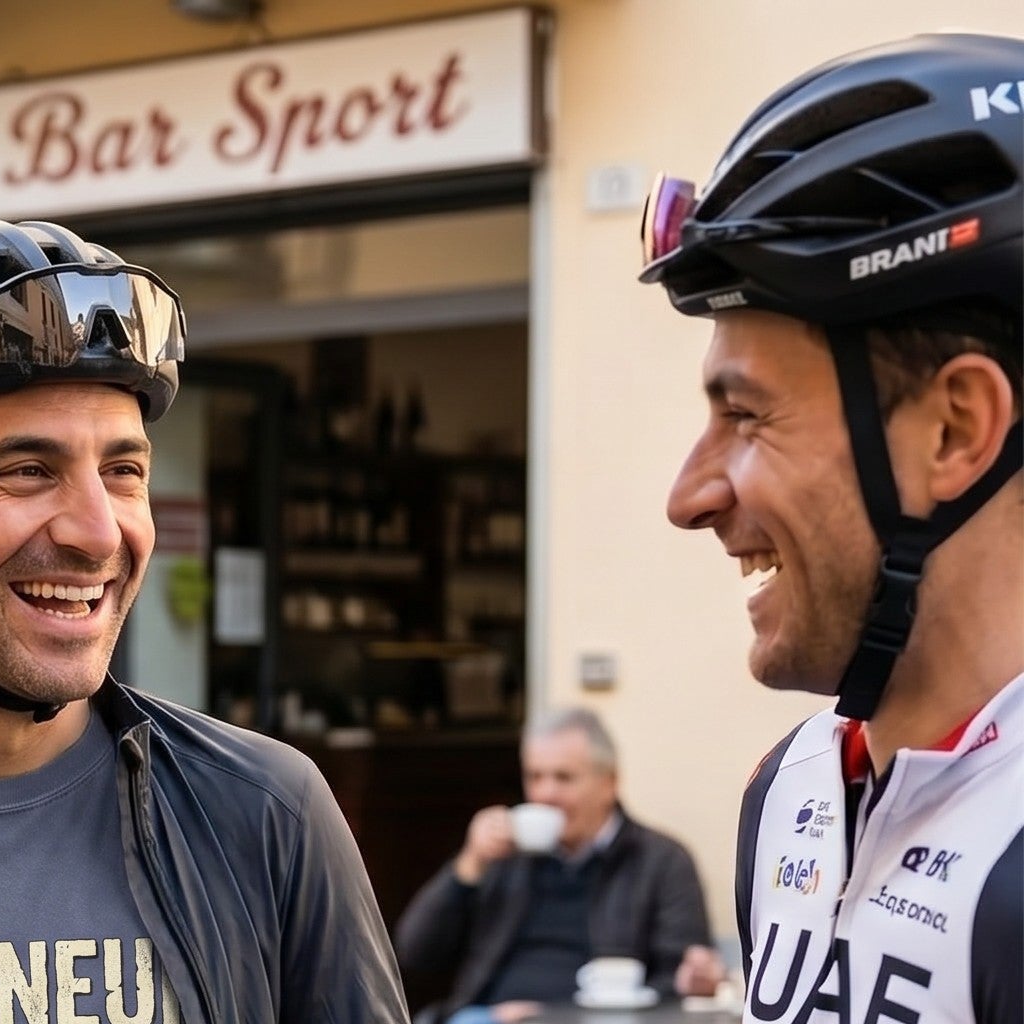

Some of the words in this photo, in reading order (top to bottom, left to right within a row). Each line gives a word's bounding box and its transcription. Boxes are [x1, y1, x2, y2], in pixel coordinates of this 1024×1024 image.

[2, 91, 182, 187] Bar
[213, 51, 468, 175] Sport
[970, 81, 1024, 121] K
